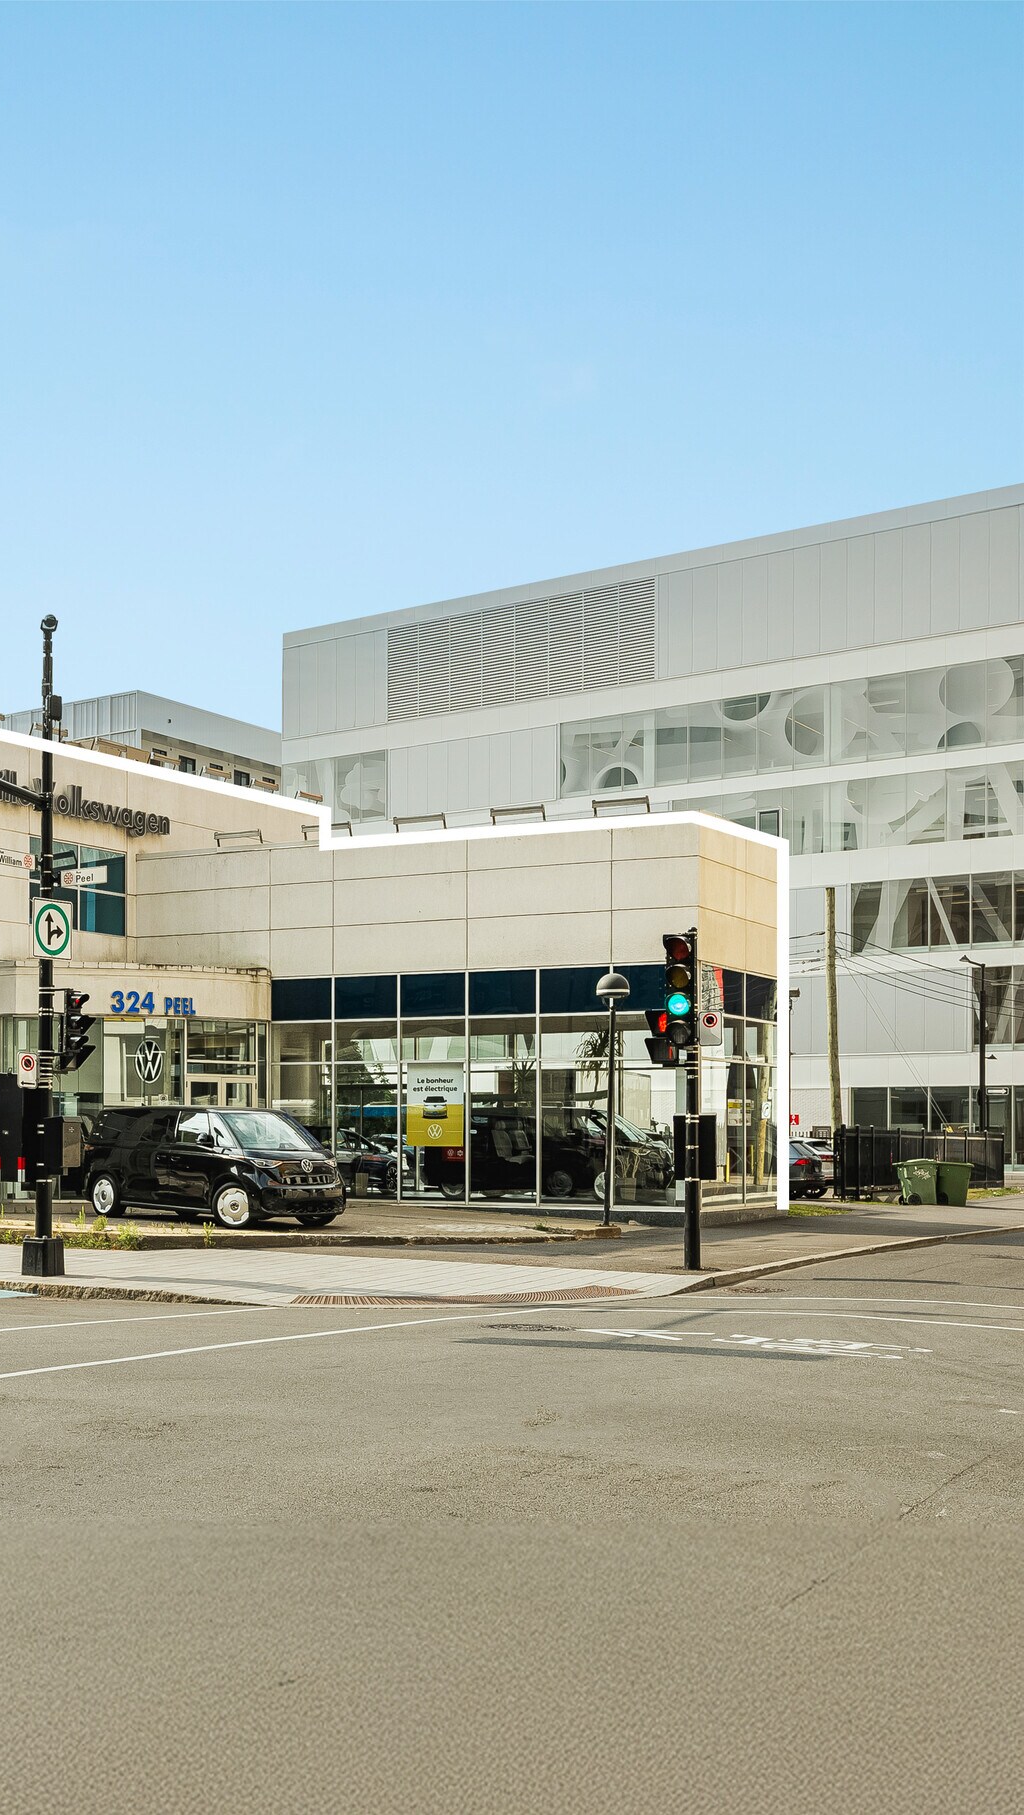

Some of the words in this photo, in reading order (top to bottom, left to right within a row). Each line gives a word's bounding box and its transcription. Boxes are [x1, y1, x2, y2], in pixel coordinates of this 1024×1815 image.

[76, 873, 94, 883] Peel
[111, 991, 155, 1014] 324
[164, 997, 196, 1015] PEEL
